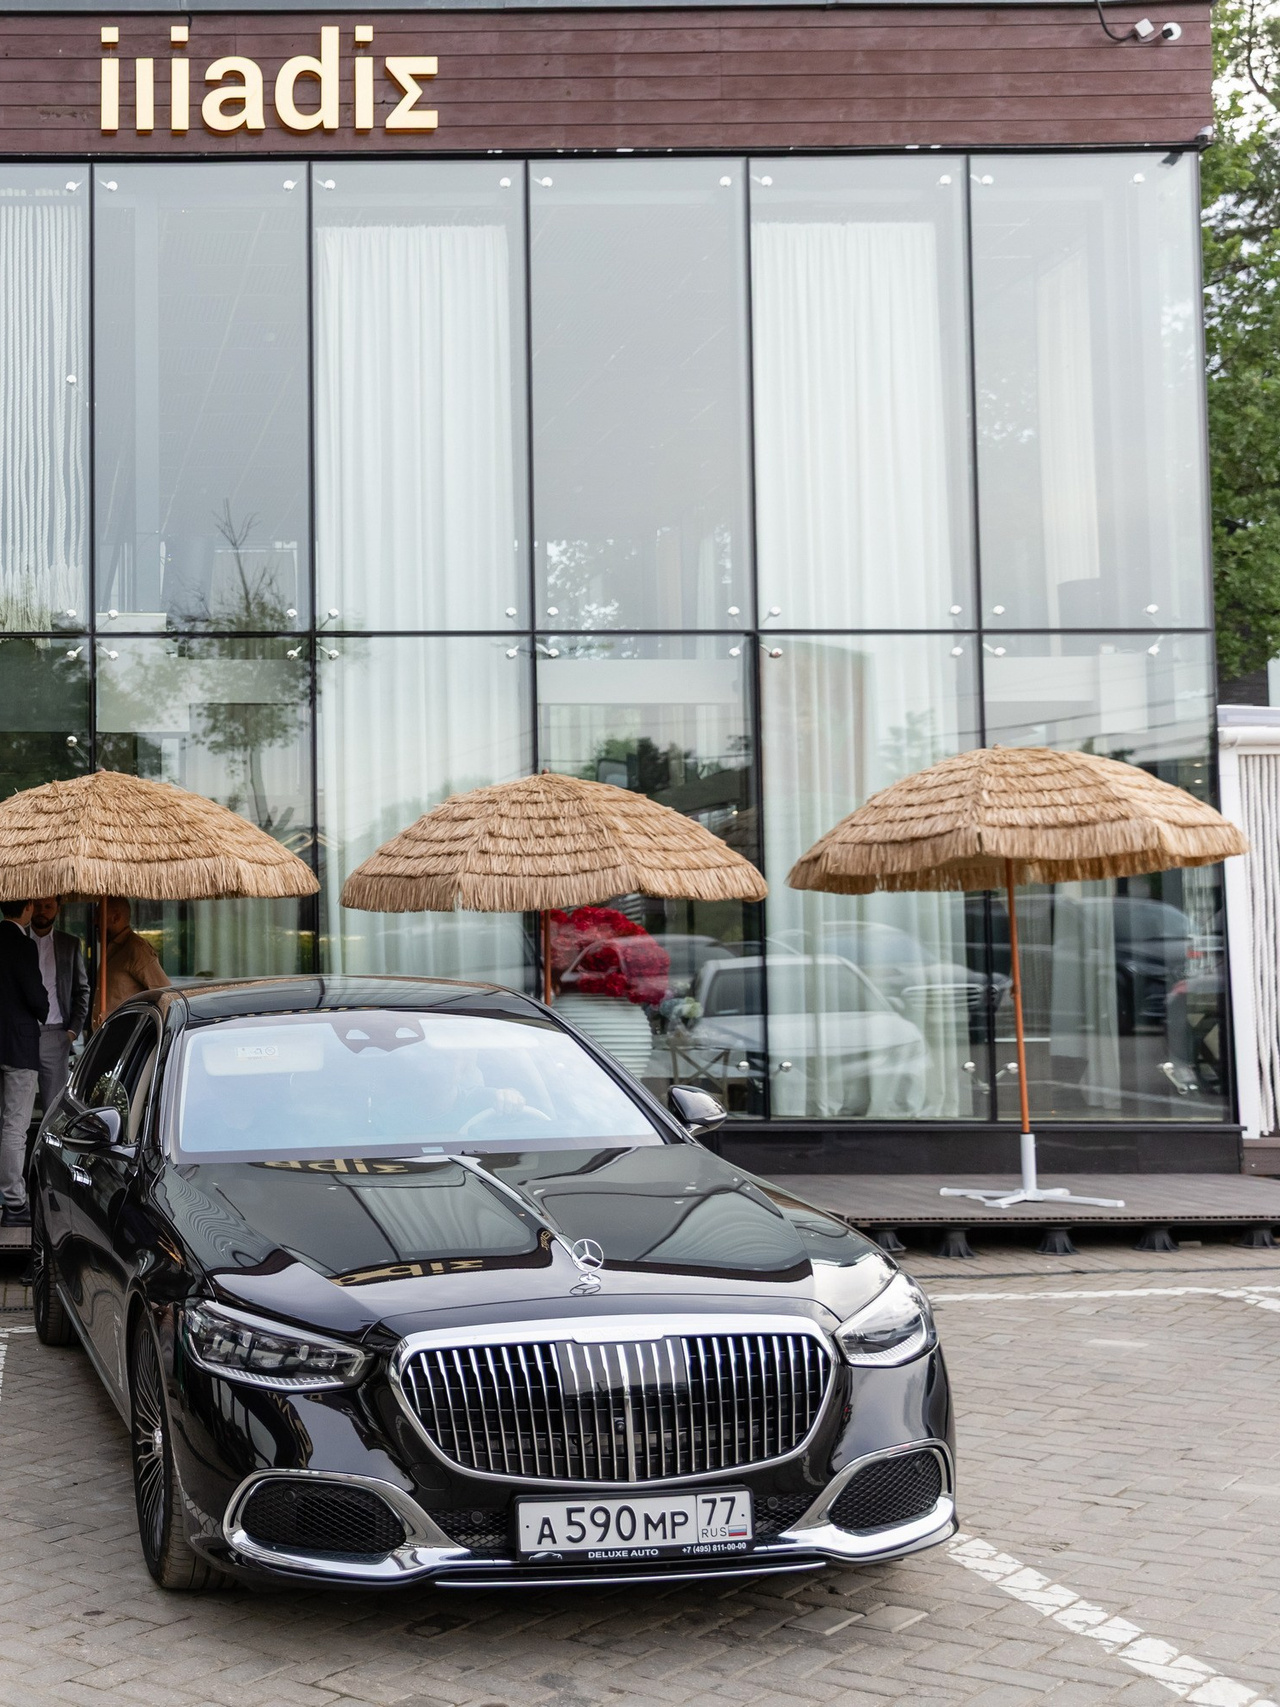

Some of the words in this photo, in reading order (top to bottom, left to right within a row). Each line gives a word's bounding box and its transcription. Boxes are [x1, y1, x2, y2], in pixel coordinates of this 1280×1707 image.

[701, 1496, 736, 1526] 77
[701, 1526, 728, 1539] RUS
[587, 1549, 629, 1560] DELUXE
[630, 1547, 659, 1558] AUTO
[681, 1546, 692, 1554] +7
[692, 1544, 711, 1554] (495)
[712, 1541, 747, 1552] 811-00-00
